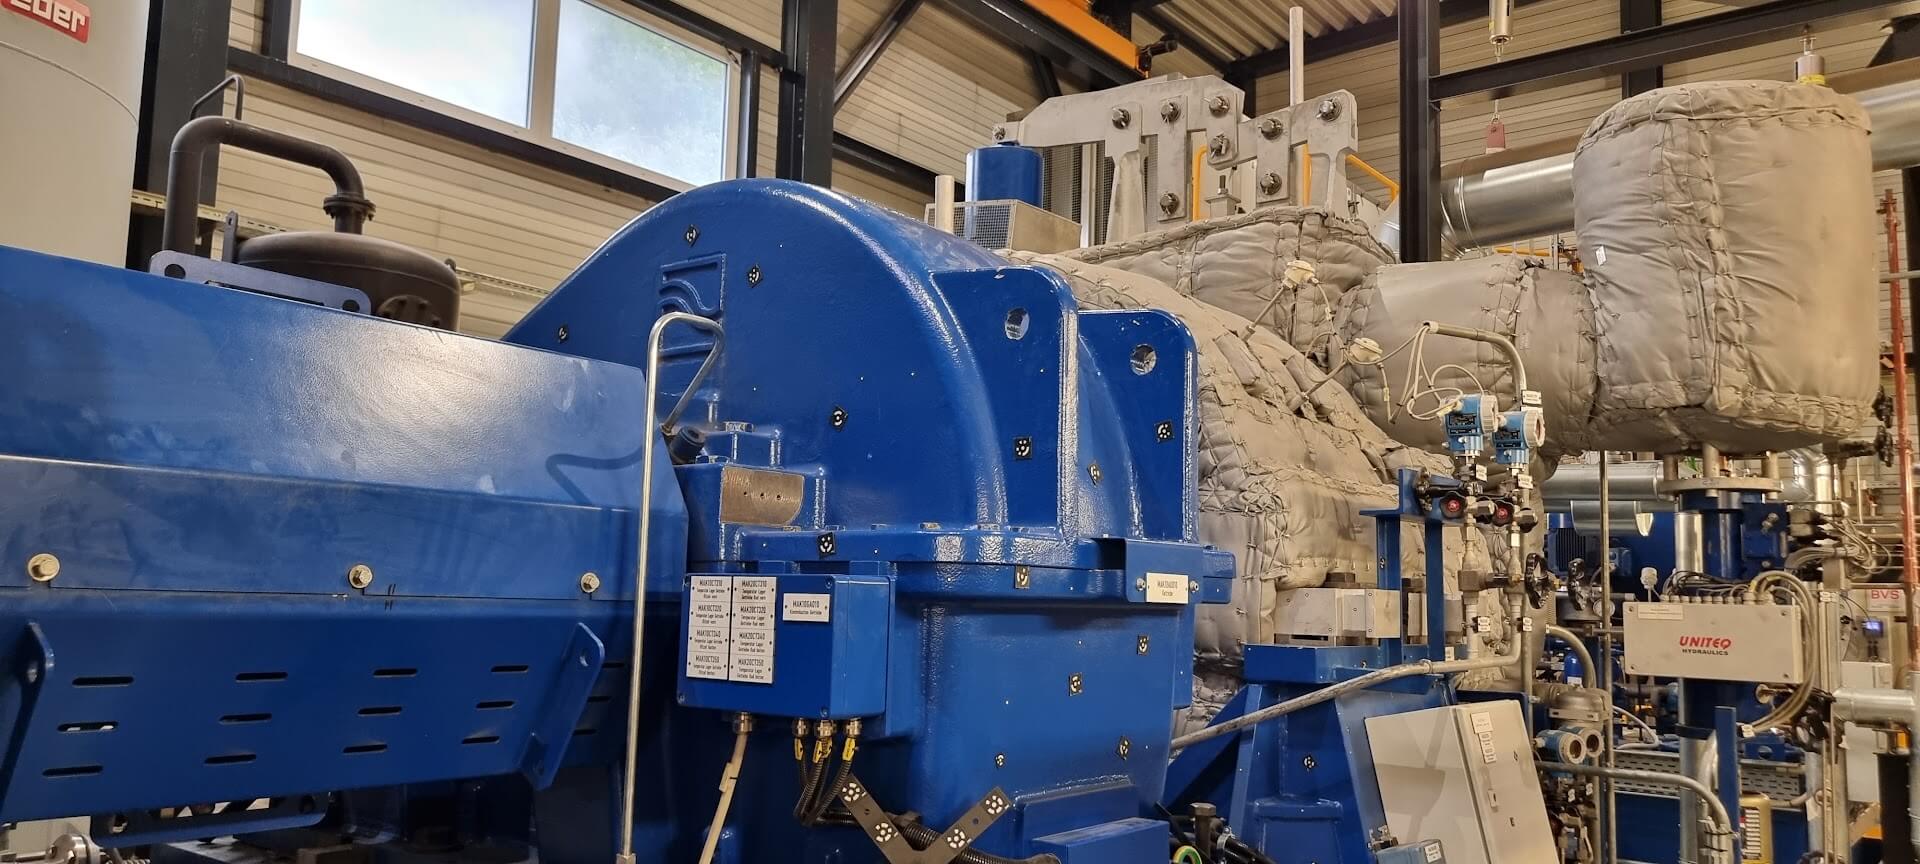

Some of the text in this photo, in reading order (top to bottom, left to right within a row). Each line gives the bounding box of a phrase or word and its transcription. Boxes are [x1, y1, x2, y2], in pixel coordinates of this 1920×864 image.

[1871, 590, 1900, 600] BVS
[1679, 635, 1732, 650] UNITEQ
[1682, 648, 1729, 656] HYDRAULICS
